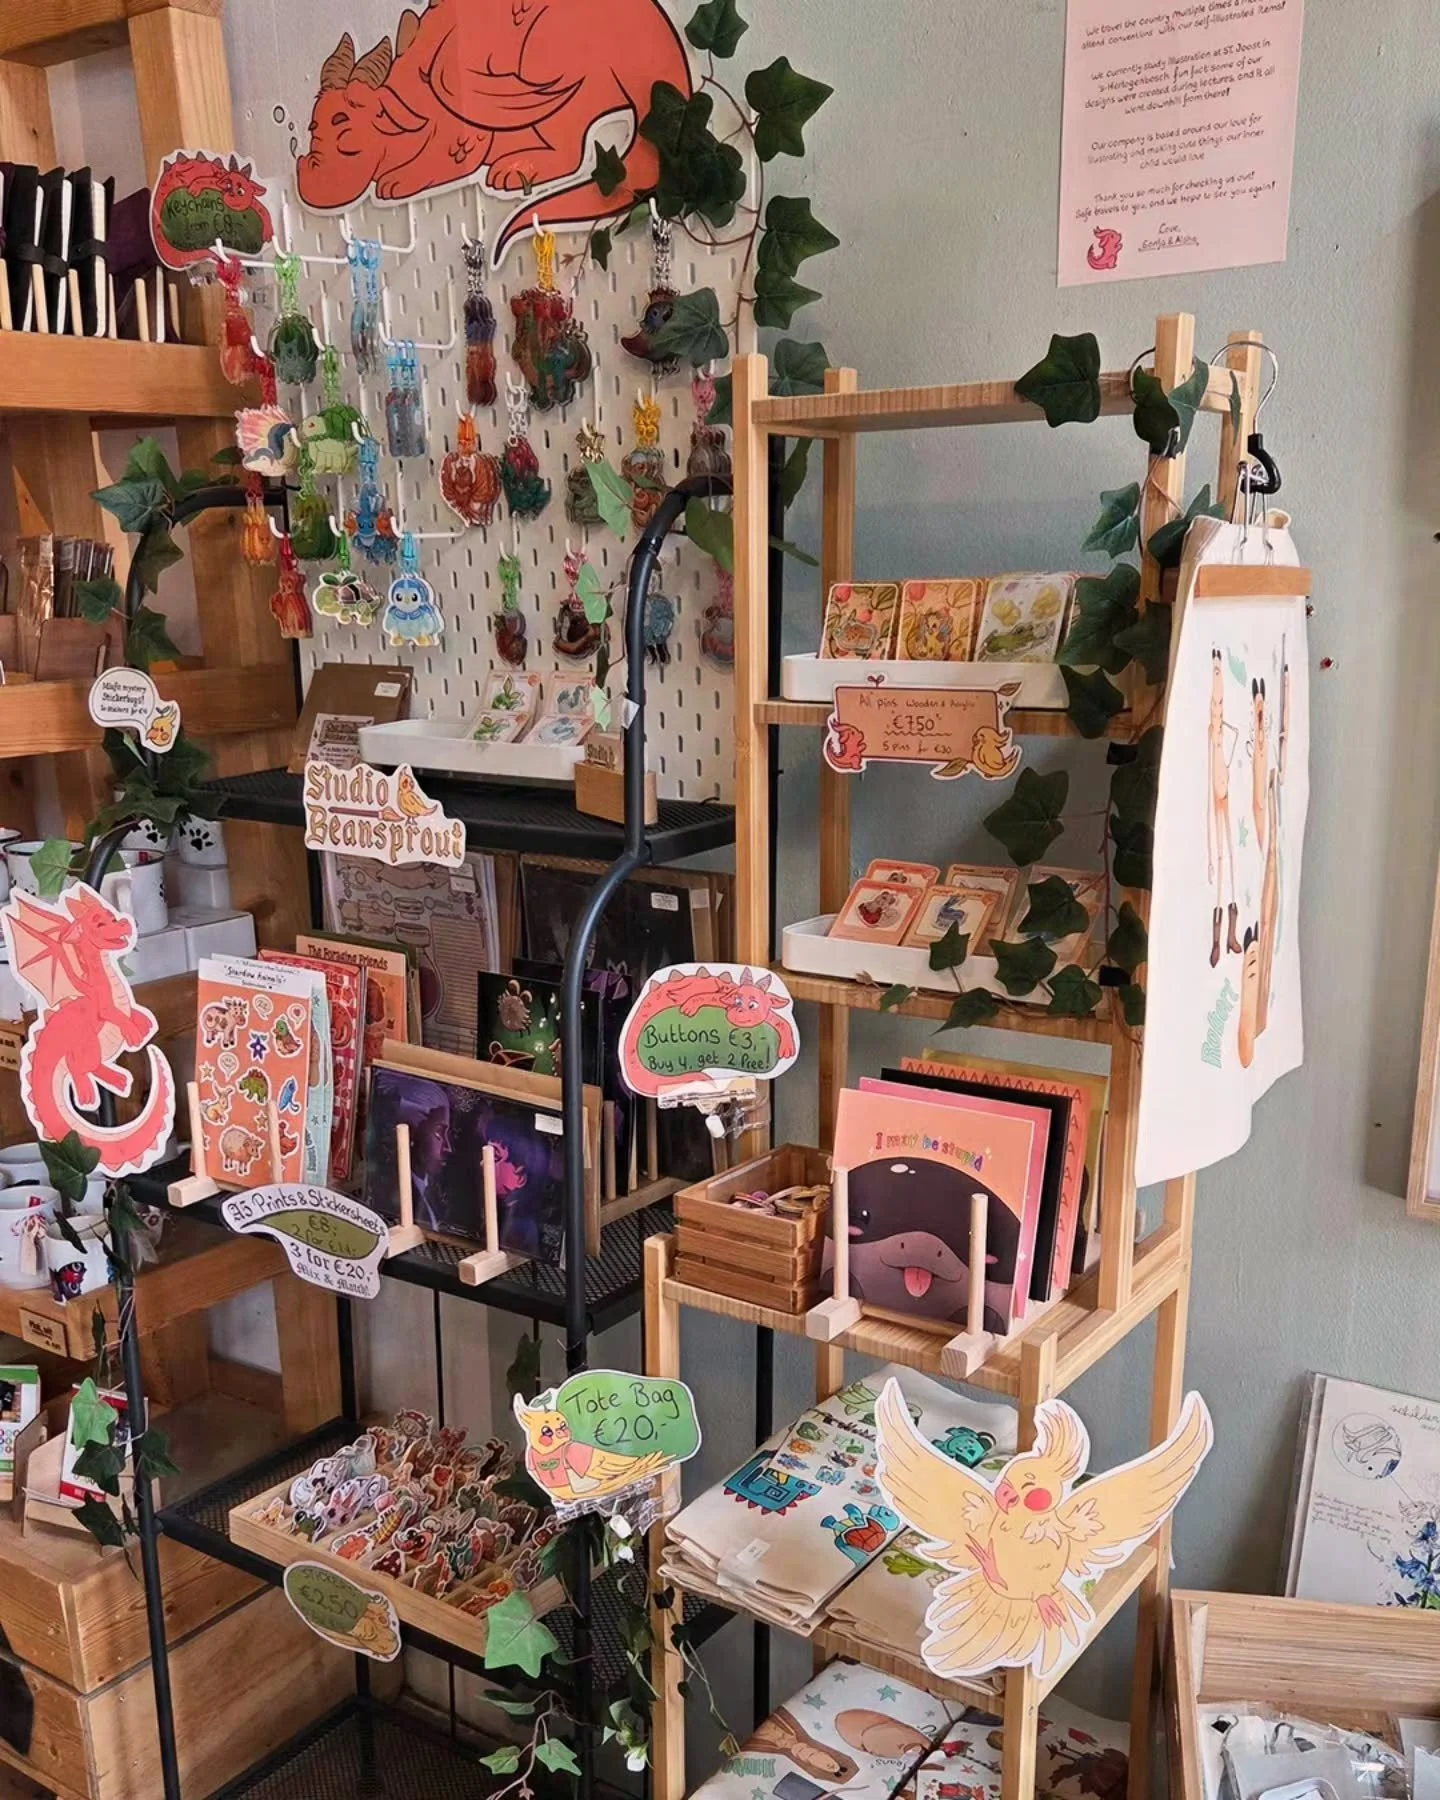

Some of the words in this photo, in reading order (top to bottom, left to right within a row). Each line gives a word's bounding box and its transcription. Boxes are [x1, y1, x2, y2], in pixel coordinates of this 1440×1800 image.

[306, 763, 390, 807] Studio
[305, 802, 466, 864] Beansprout
[643, 1023, 722, 1049] Buttons
[646, 1054, 675, 1073] Buy
[697, 1049, 721, 1068] get
[727, 1053, 737, 1066] 2
[875, 1132, 884, 1150] I
[250, 1187, 298, 1213] Prints
[288, 1241, 302, 1258] 3
[306, 1247, 330, 1271] for
[563, 1387, 622, 1416] Tote
[629, 1381, 680, 1420] Bag
